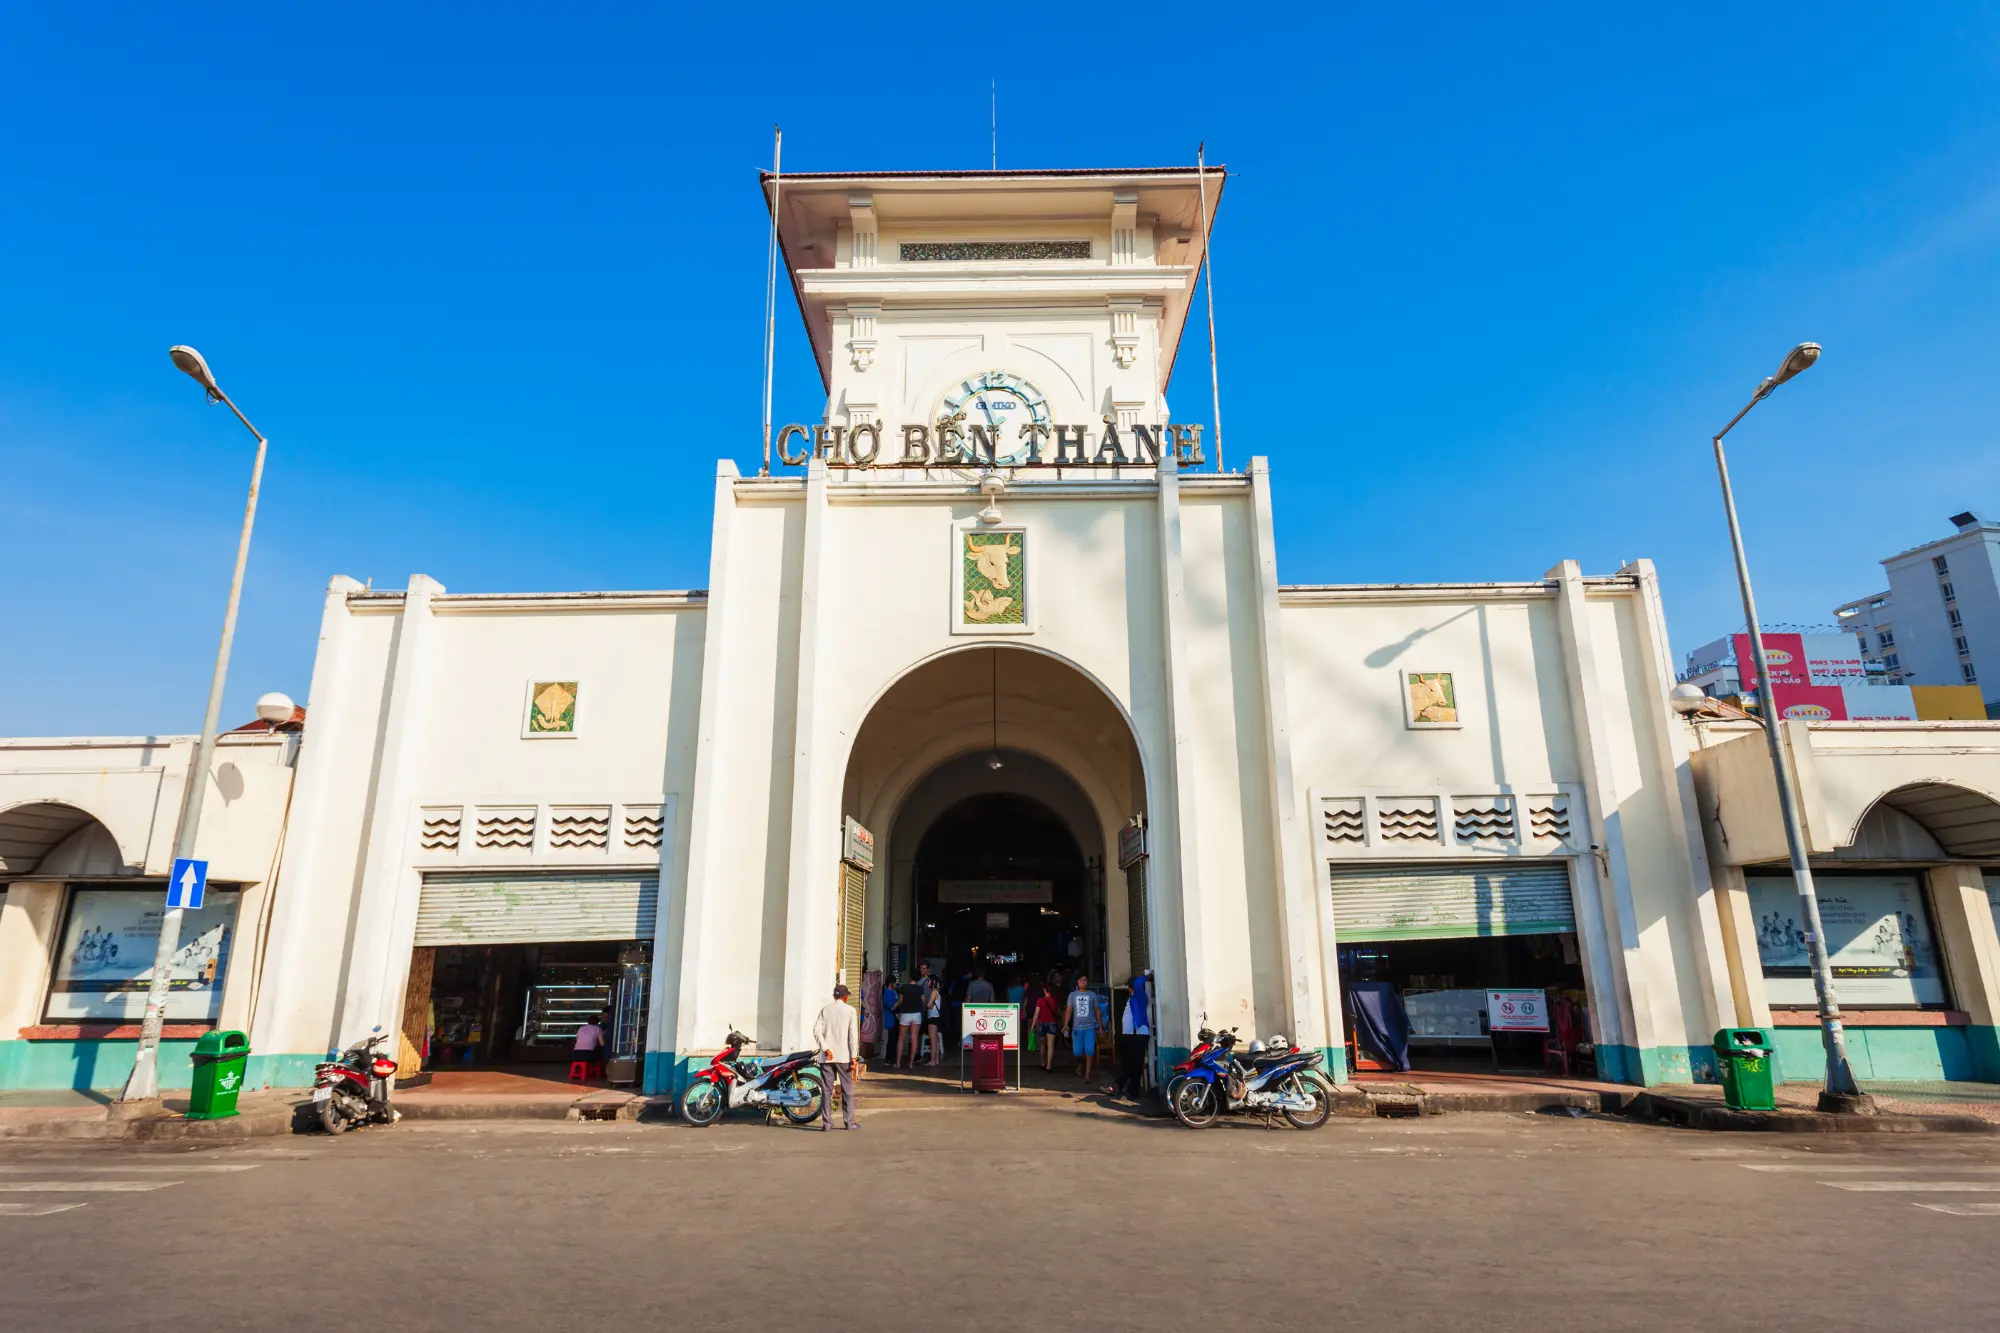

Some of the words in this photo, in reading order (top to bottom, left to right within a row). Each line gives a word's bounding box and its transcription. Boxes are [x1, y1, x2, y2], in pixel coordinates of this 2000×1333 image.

[776, 418, 883, 471] CHỢ
[899, 411, 1000, 465] BẾN
[1018, 414, 1205, 464] THÀNH
